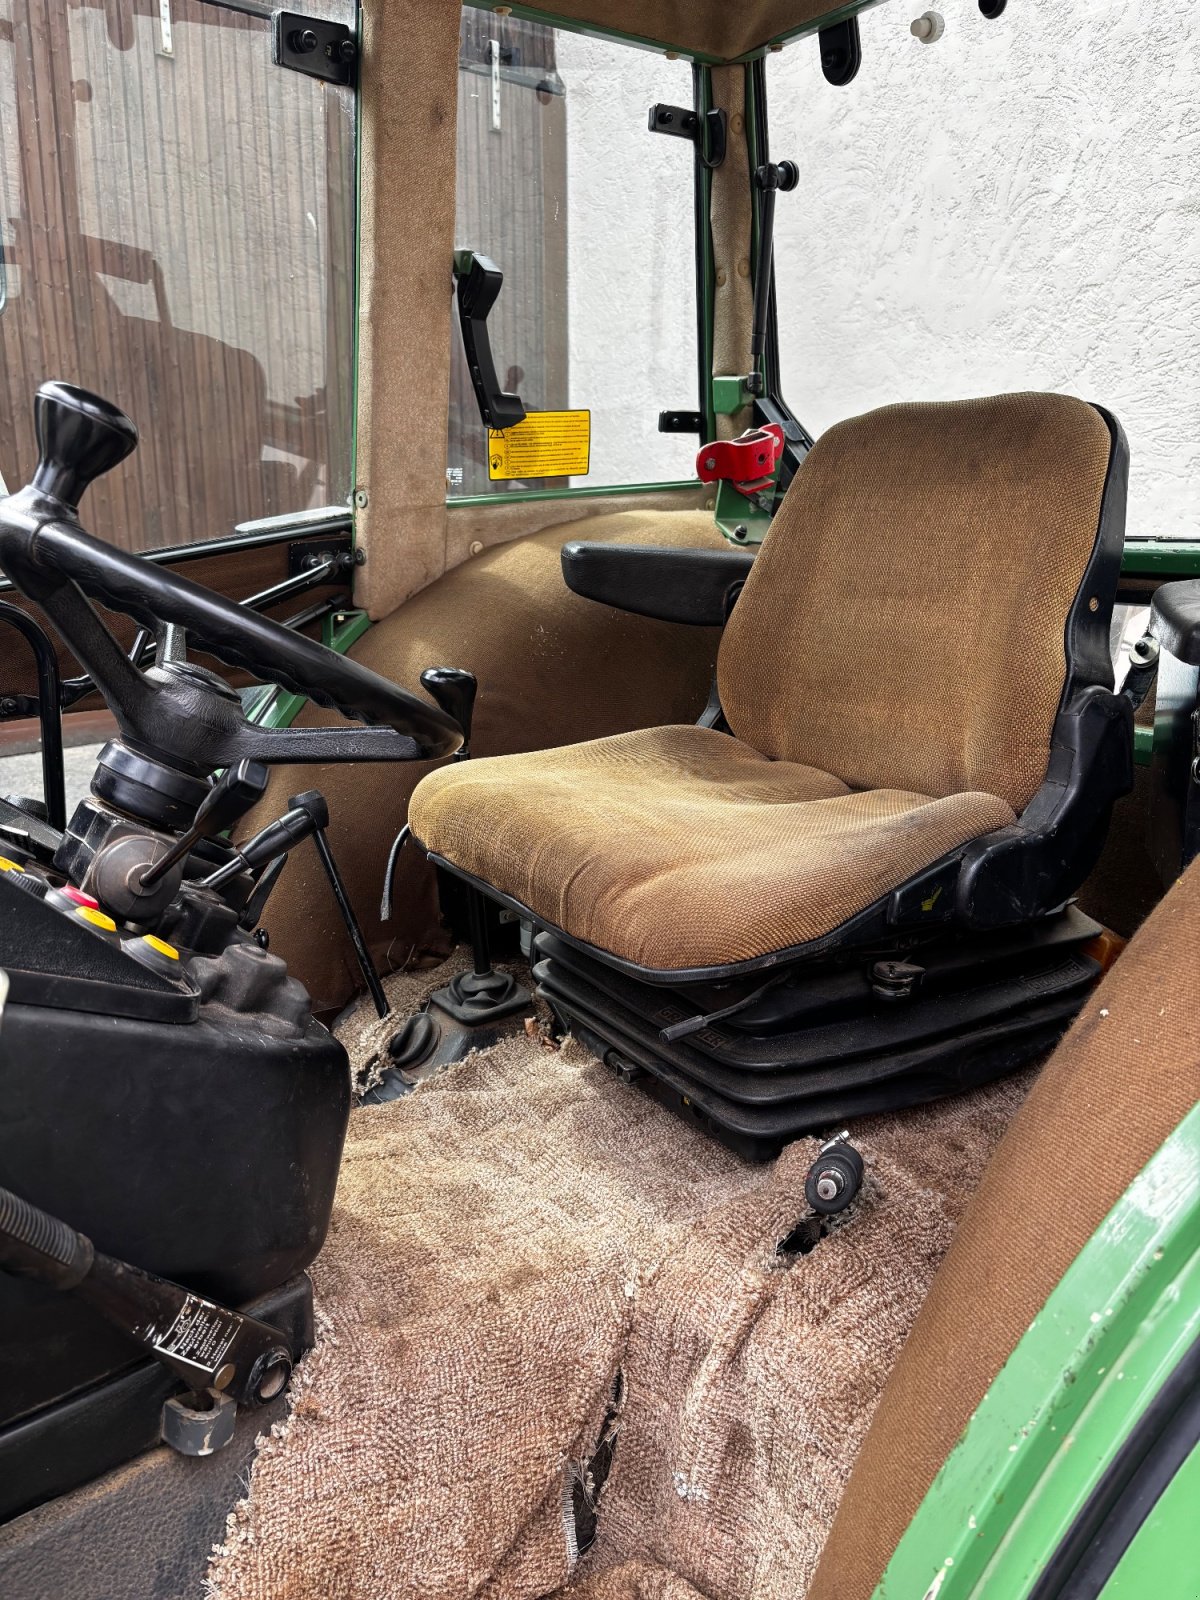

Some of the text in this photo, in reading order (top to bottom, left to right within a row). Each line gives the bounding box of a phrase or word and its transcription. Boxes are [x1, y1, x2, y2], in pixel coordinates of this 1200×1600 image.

[179, 1311, 204, 1350] Nach der
[193, 1323, 209, 1349] arbeit
[204, 1346, 212, 1359] auf
[211, 1337, 225, 1359] Hebel
[214, 1341, 227, 1362] vorne
